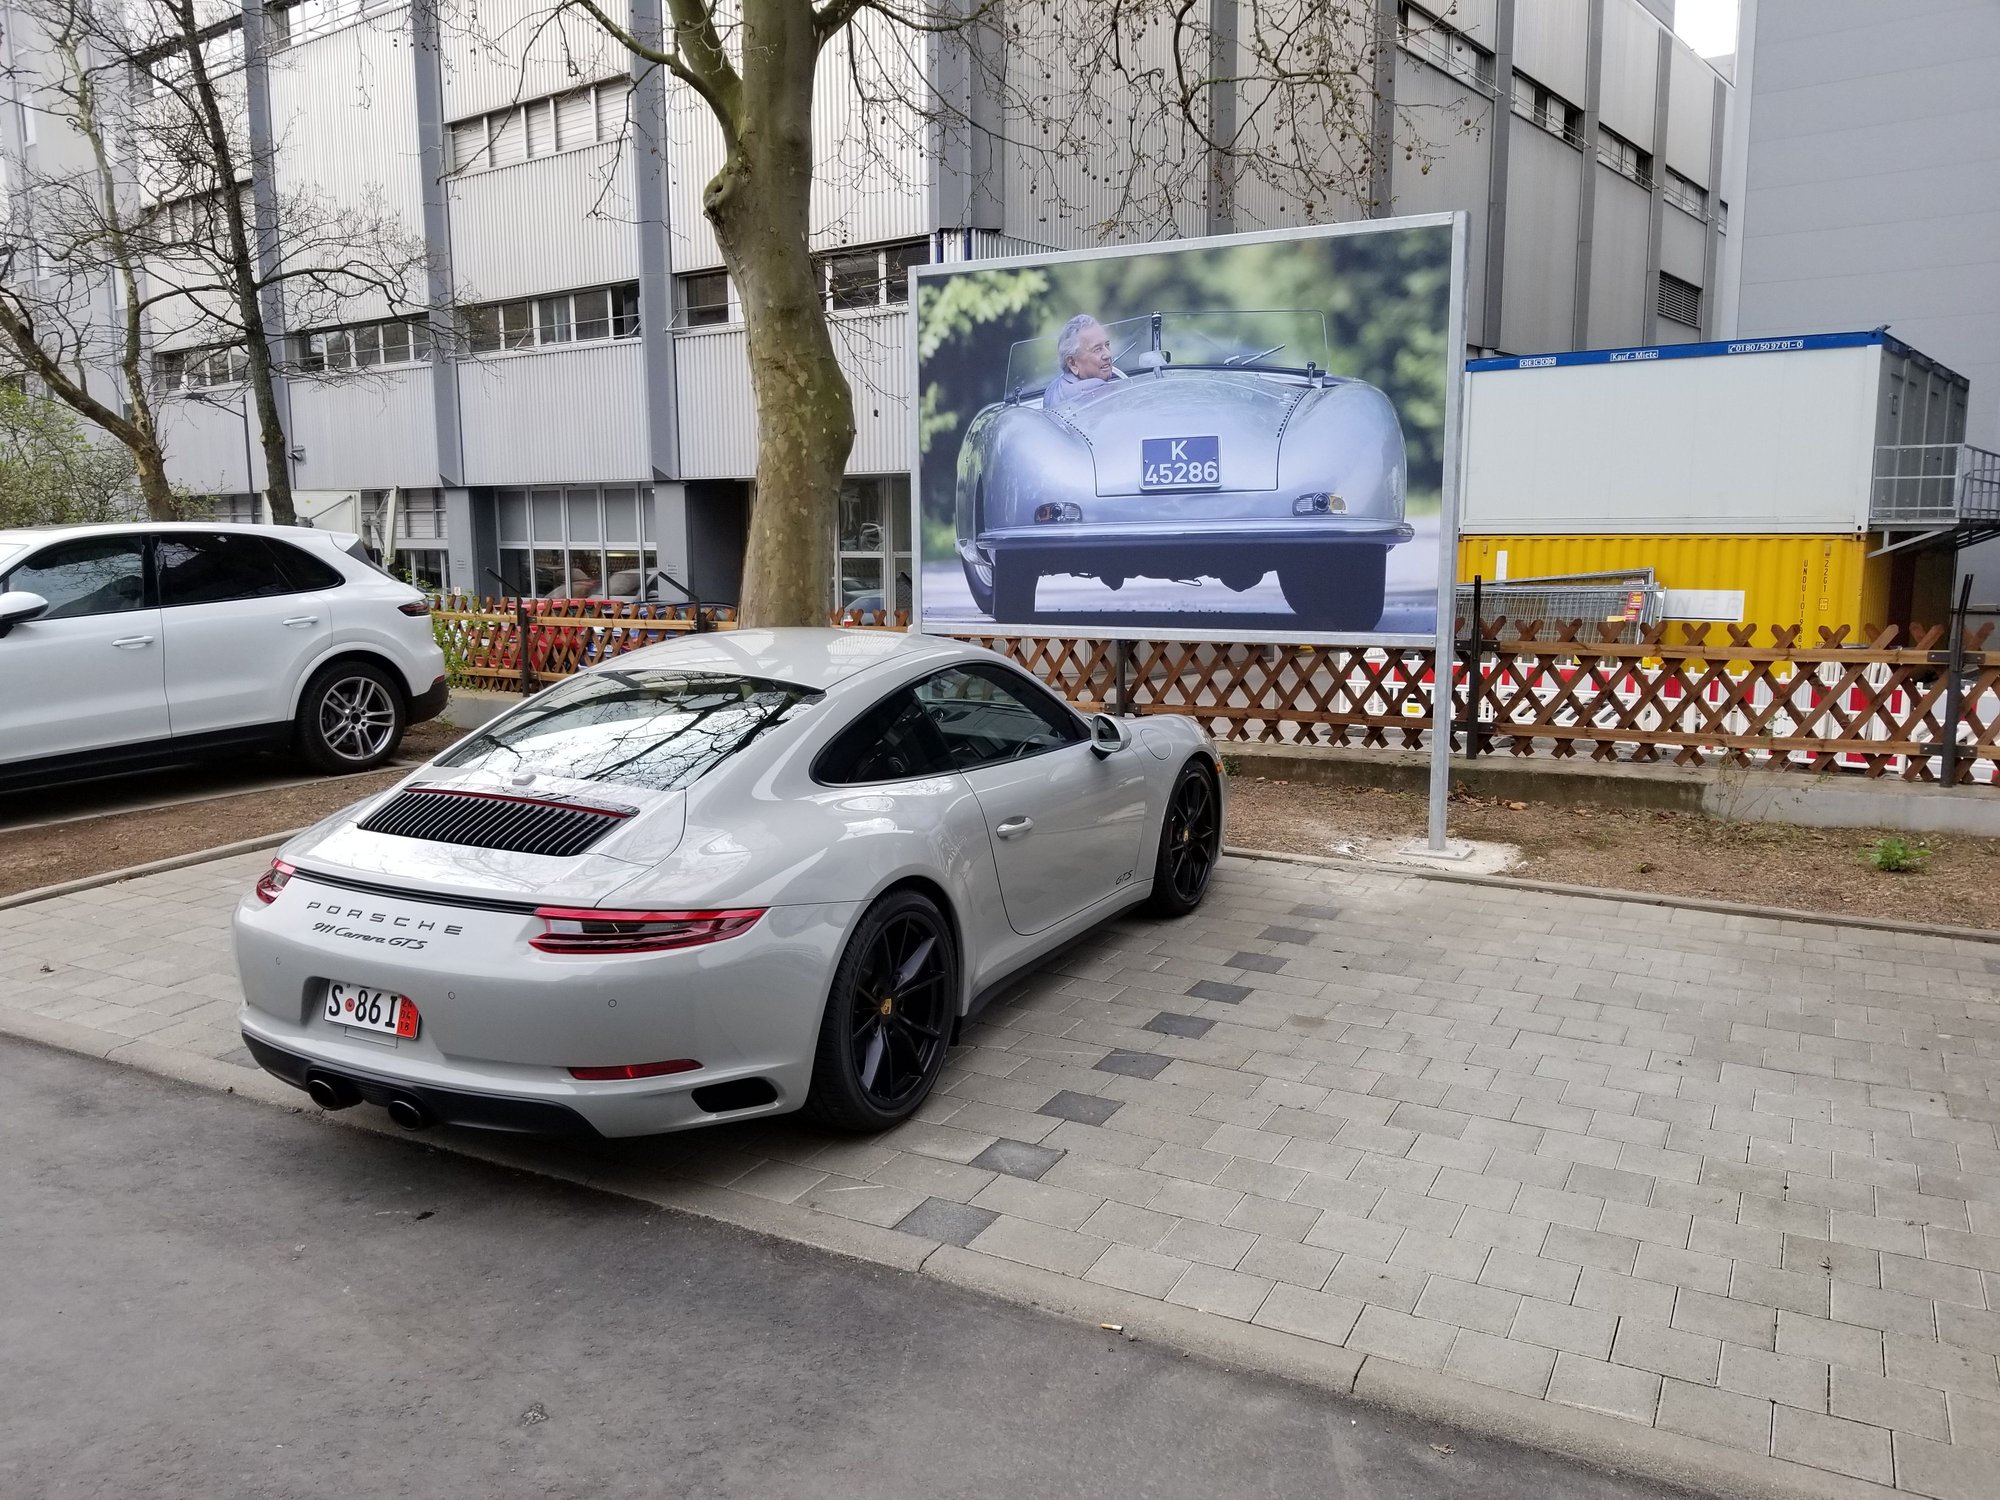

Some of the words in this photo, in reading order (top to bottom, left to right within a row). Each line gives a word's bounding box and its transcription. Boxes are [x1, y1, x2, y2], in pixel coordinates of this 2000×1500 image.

[1521, 357, 1556, 368] OECON
[1171, 440, 1188, 460] K
[1145, 461, 1218, 484] 45286
[1115, 869, 1134, 885] GTS
[306, 901, 464, 935] PORSCHE
[312, 922, 336, 933] 911
[334, 927, 386, 944] Carrera
[388, 937, 429, 950] GTS
[328, 984, 344, 1017] S
